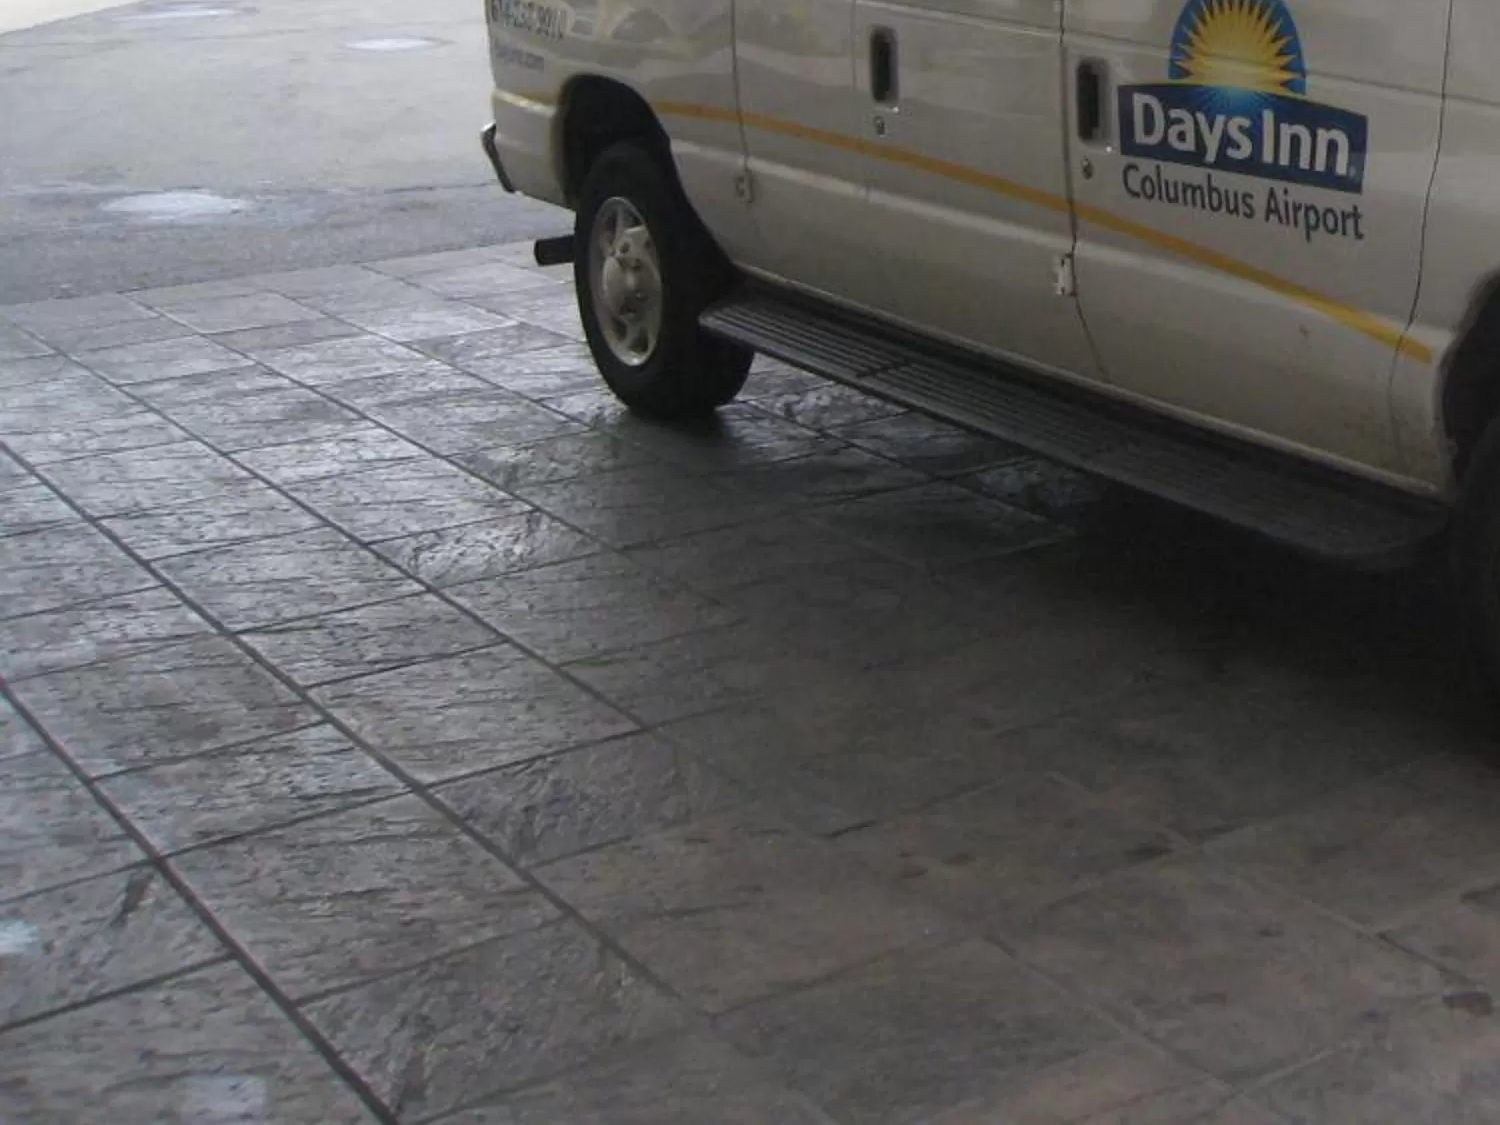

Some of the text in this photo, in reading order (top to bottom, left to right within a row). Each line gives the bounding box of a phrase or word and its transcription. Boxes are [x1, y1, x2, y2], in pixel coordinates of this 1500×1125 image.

[1132, 92, 1350, 176] Days Inn
[1122, 163, 1364, 242] Columbus Airport
